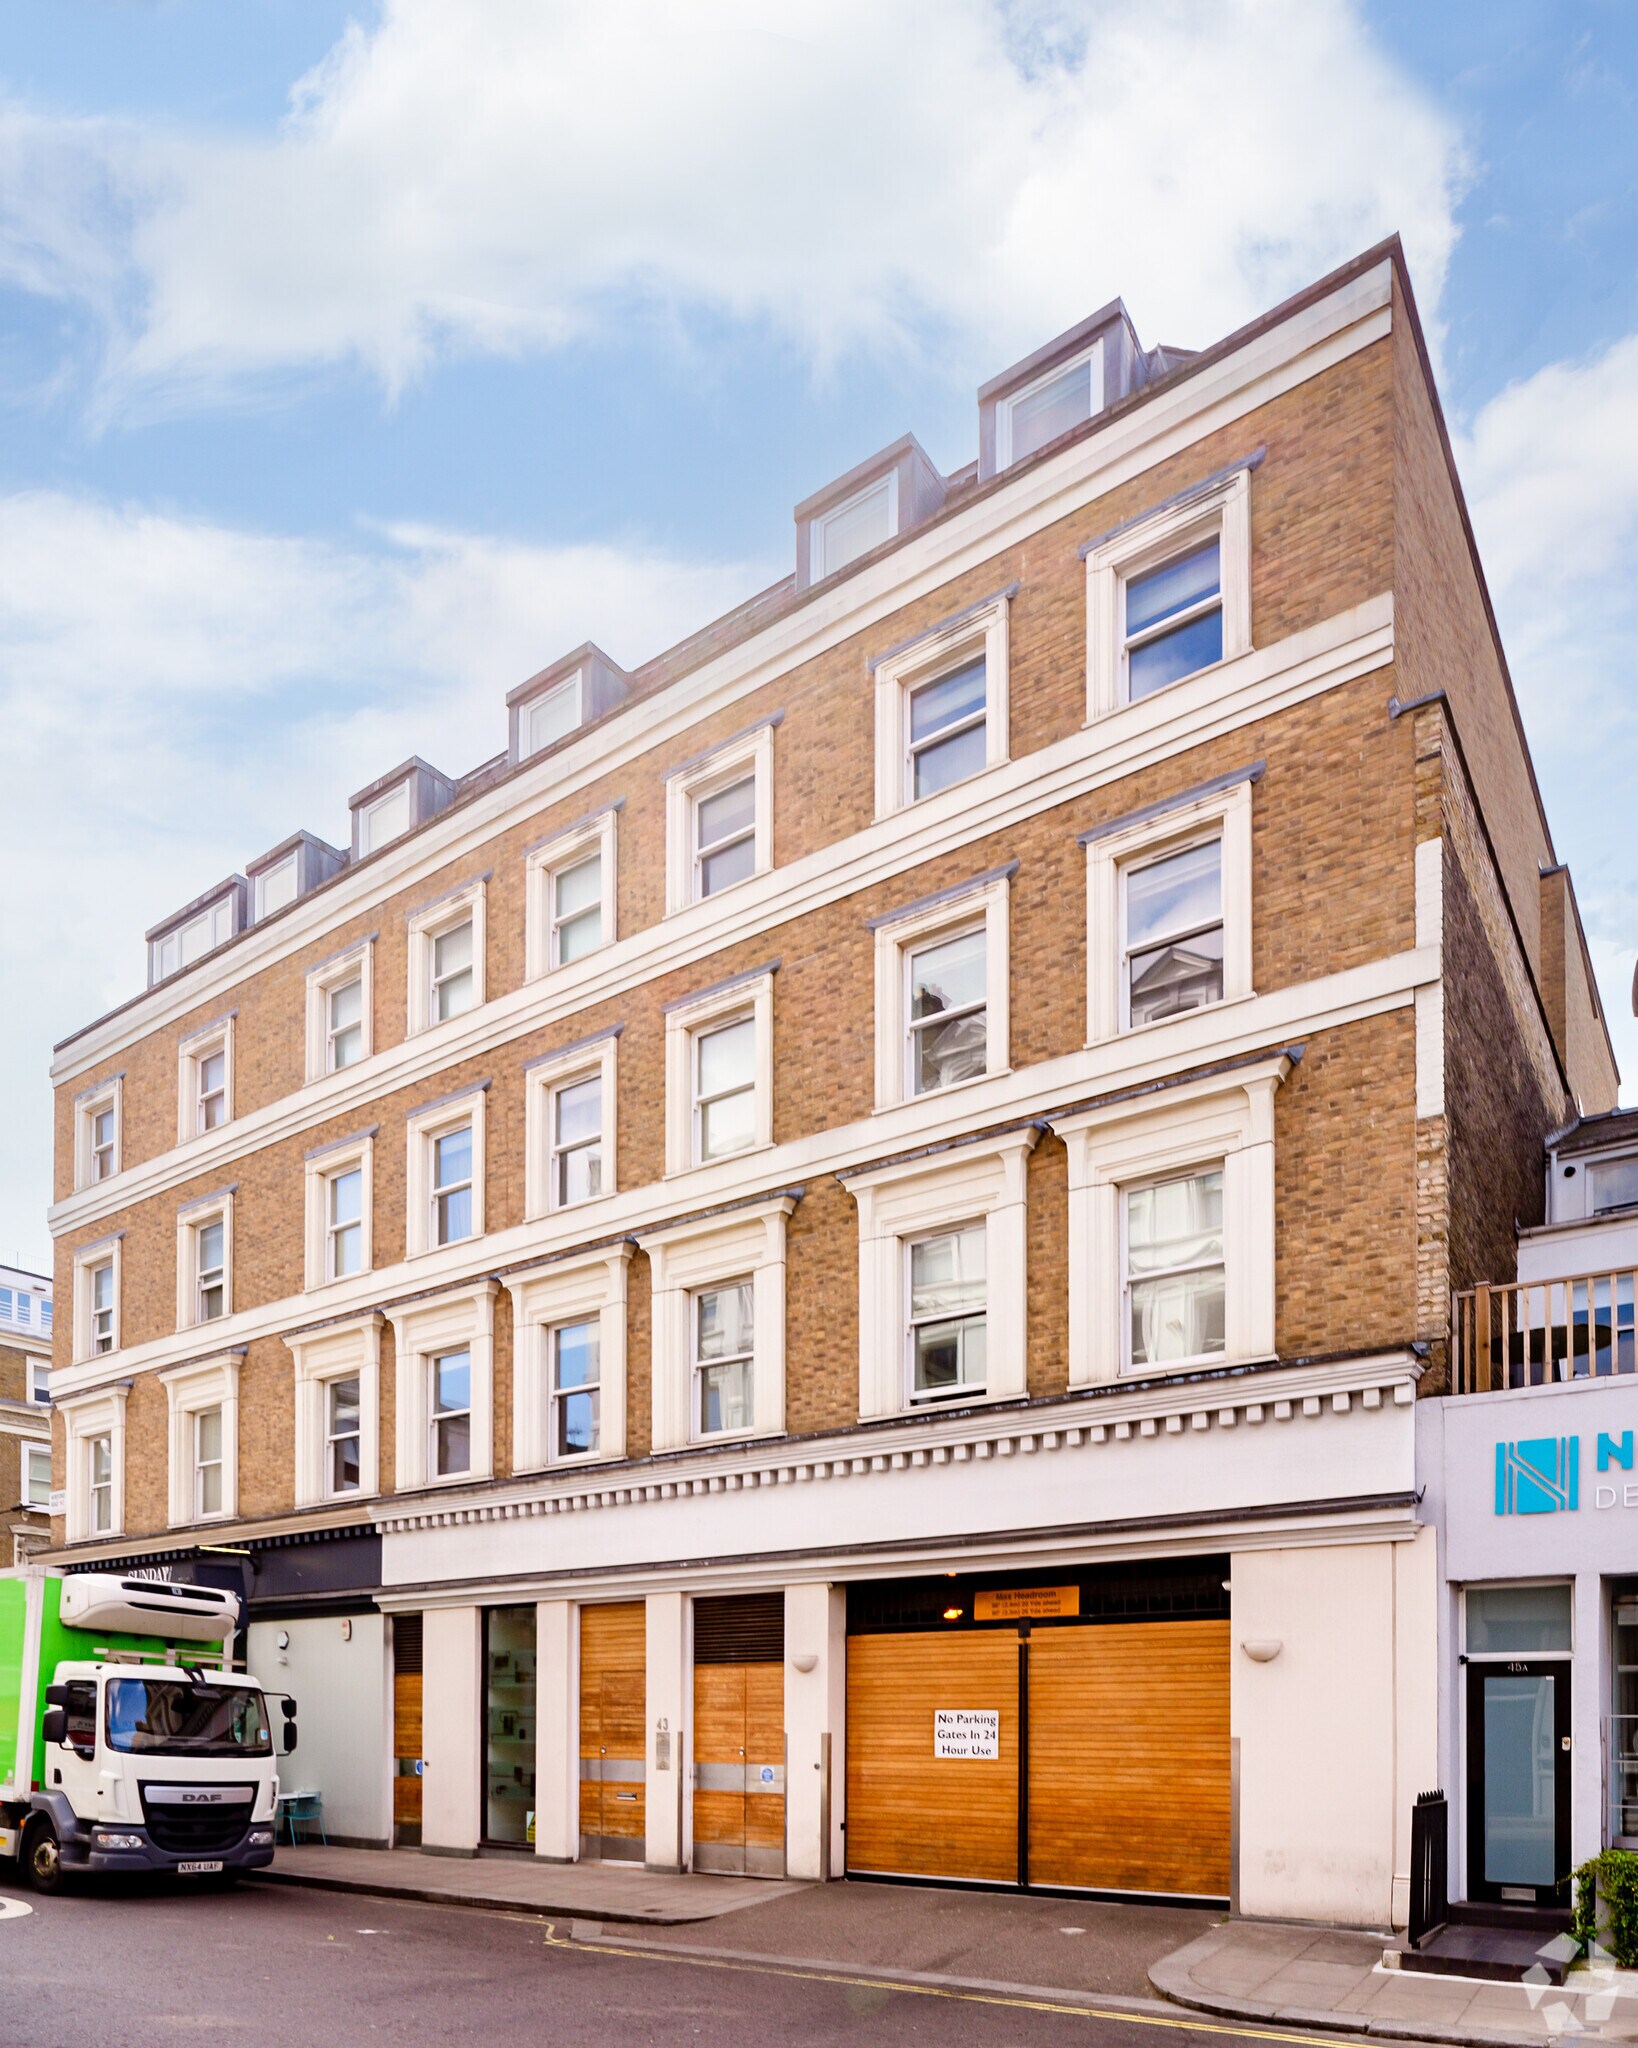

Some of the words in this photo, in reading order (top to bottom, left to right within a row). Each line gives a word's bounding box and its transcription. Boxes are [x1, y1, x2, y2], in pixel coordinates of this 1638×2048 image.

[995, 1592, 1012, 1600] Max
[1014, 1590, 1057, 1600] Headroom
[656, 1717, 669, 1731] 43
[938, 1714, 953, 1724] No
[957, 1714, 996, 1727] Parking
[937, 1729, 967, 1739] Gates
[970, 1730, 980, 1739] In
[984, 1730, 996, 1740] 24
[942, 1745, 968, 1755] Hour
[971, 1746, 991, 1755] Use
[182, 1794, 222, 1802] DAF
